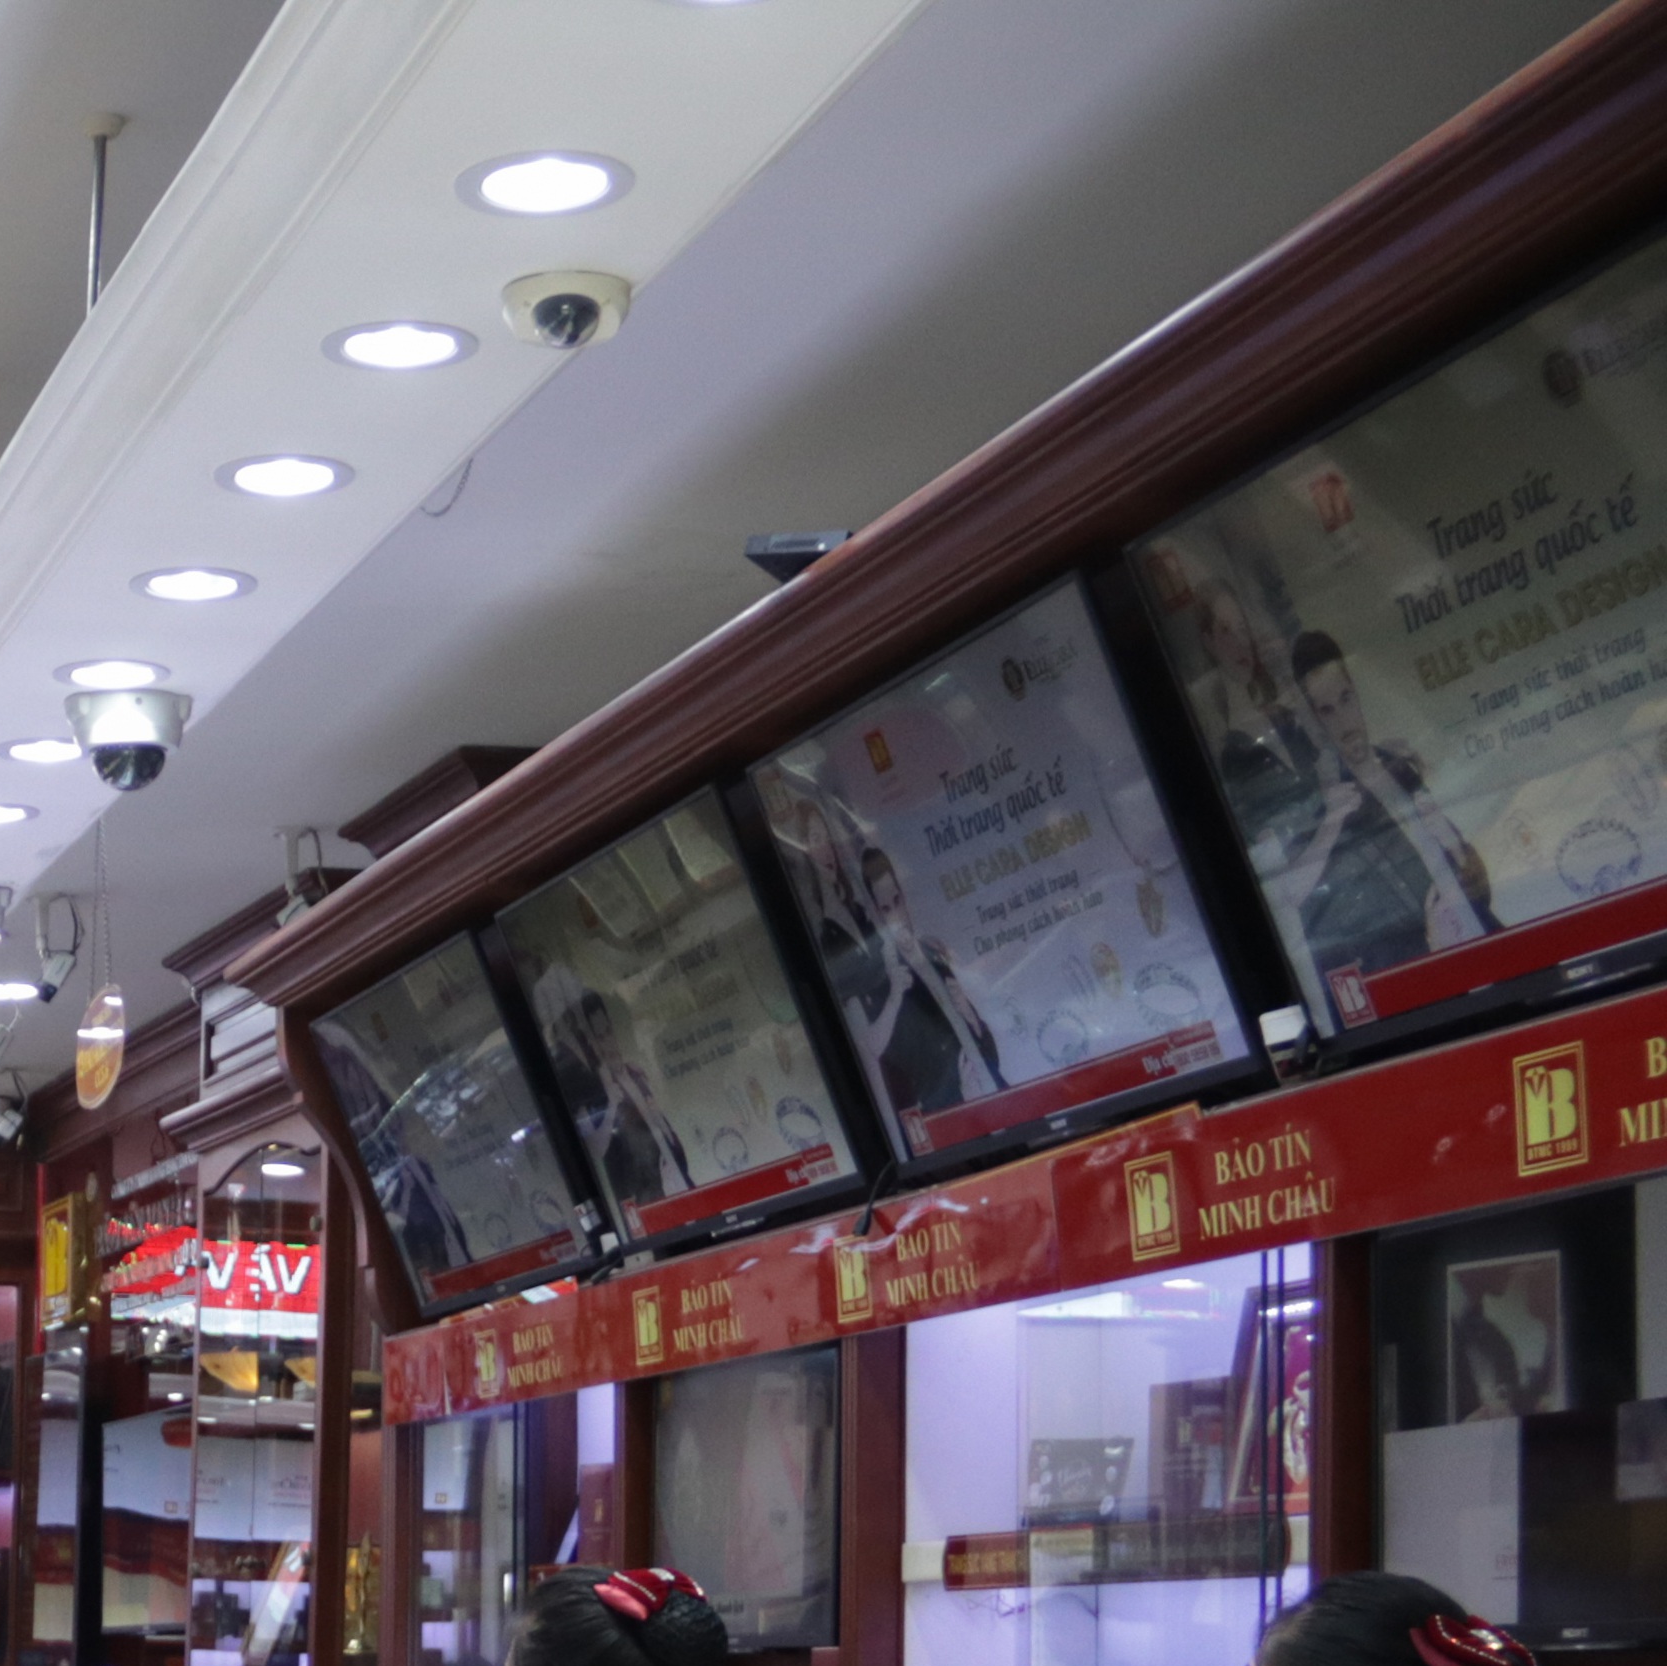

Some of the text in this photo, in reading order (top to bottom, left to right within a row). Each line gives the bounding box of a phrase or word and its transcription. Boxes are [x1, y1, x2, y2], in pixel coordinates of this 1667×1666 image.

[1426, 468, 1558, 560] Trang sức
[1453, 547, 1531, 608] trang
[1535, 498, 1603, 576] quốc
[1605, 471, 1639, 534] tế
[939, 743, 1018, 803] Trang sức
[958, 801, 1005, 842] trang
[1006, 770, 1047, 824] quốc
[1215, 1122, 1312, 1185] BẢO TÍN
[932, 1212, 963, 1253] TÍN
[1198, 1170, 1335, 1240] MINH CHÂU
[681, 1273, 734, 1314] BẢO TÍN
[885, 1254, 980, 1307] MINH CHÂU
[513, 1317, 555, 1354] BẢO TÍN
[673, 1308, 746, 1353] MINH CHÂU
[507, 1364, 533, 1388] MINH
